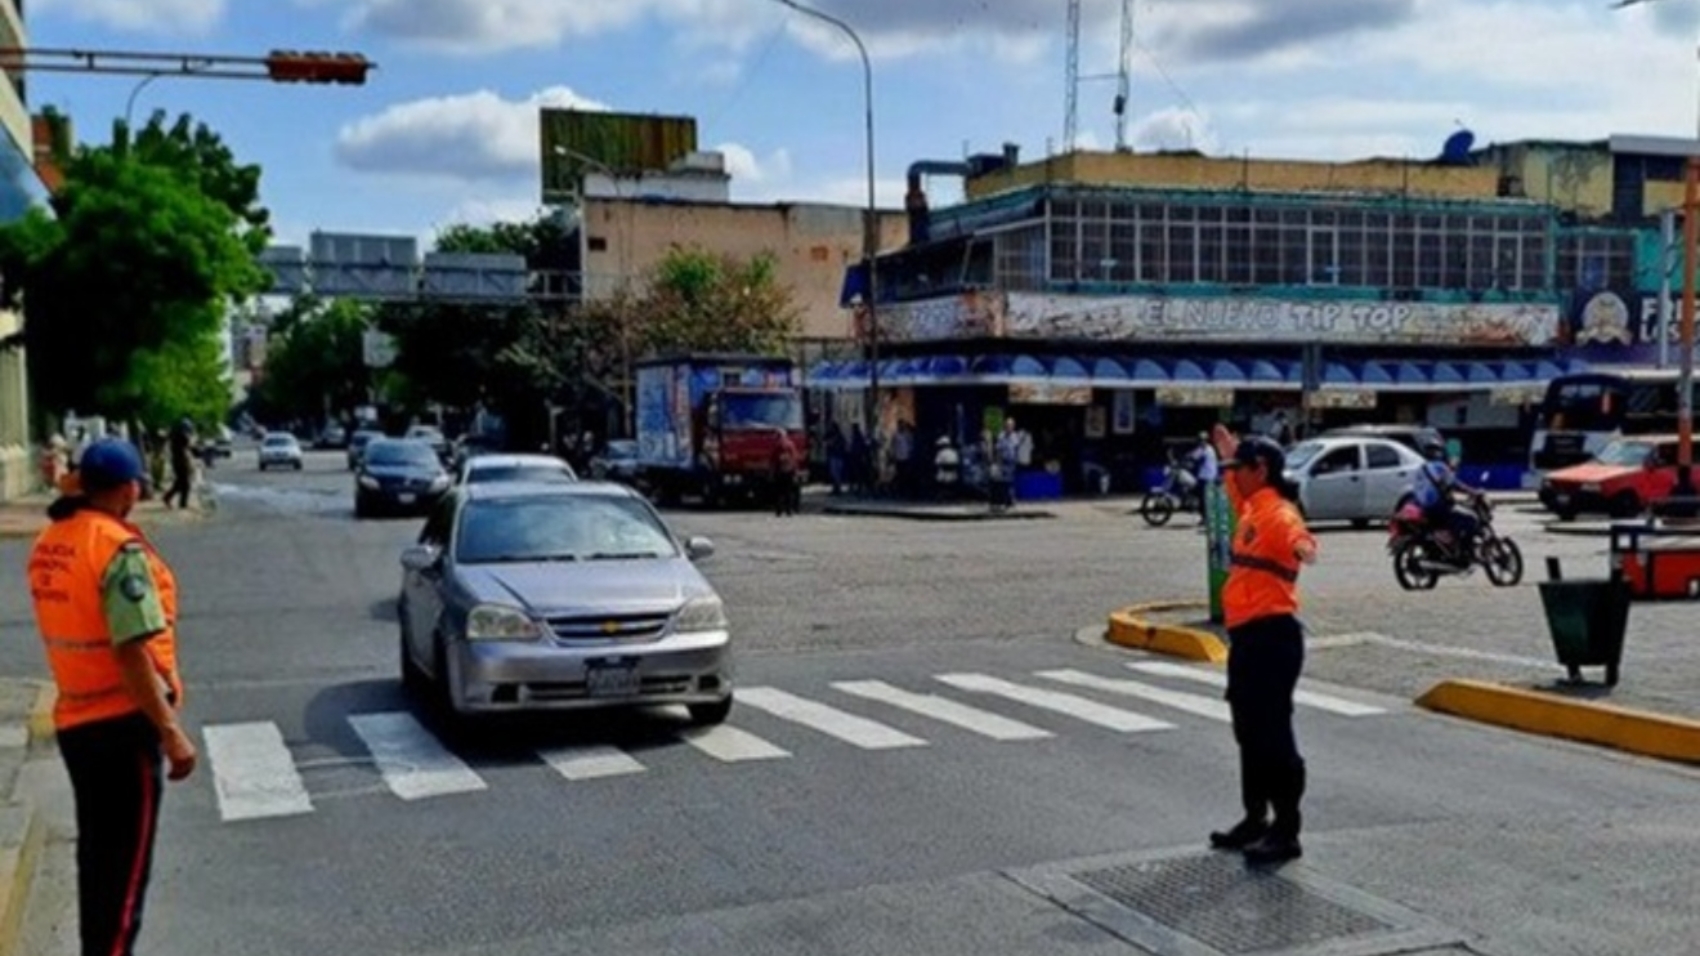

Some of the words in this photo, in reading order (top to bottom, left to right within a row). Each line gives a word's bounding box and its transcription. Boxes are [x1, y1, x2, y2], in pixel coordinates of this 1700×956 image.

[1144, 300, 1175, 327] EL
[1291, 304, 1340, 329] TIP
[1353, 304, 1409, 329] TOP
